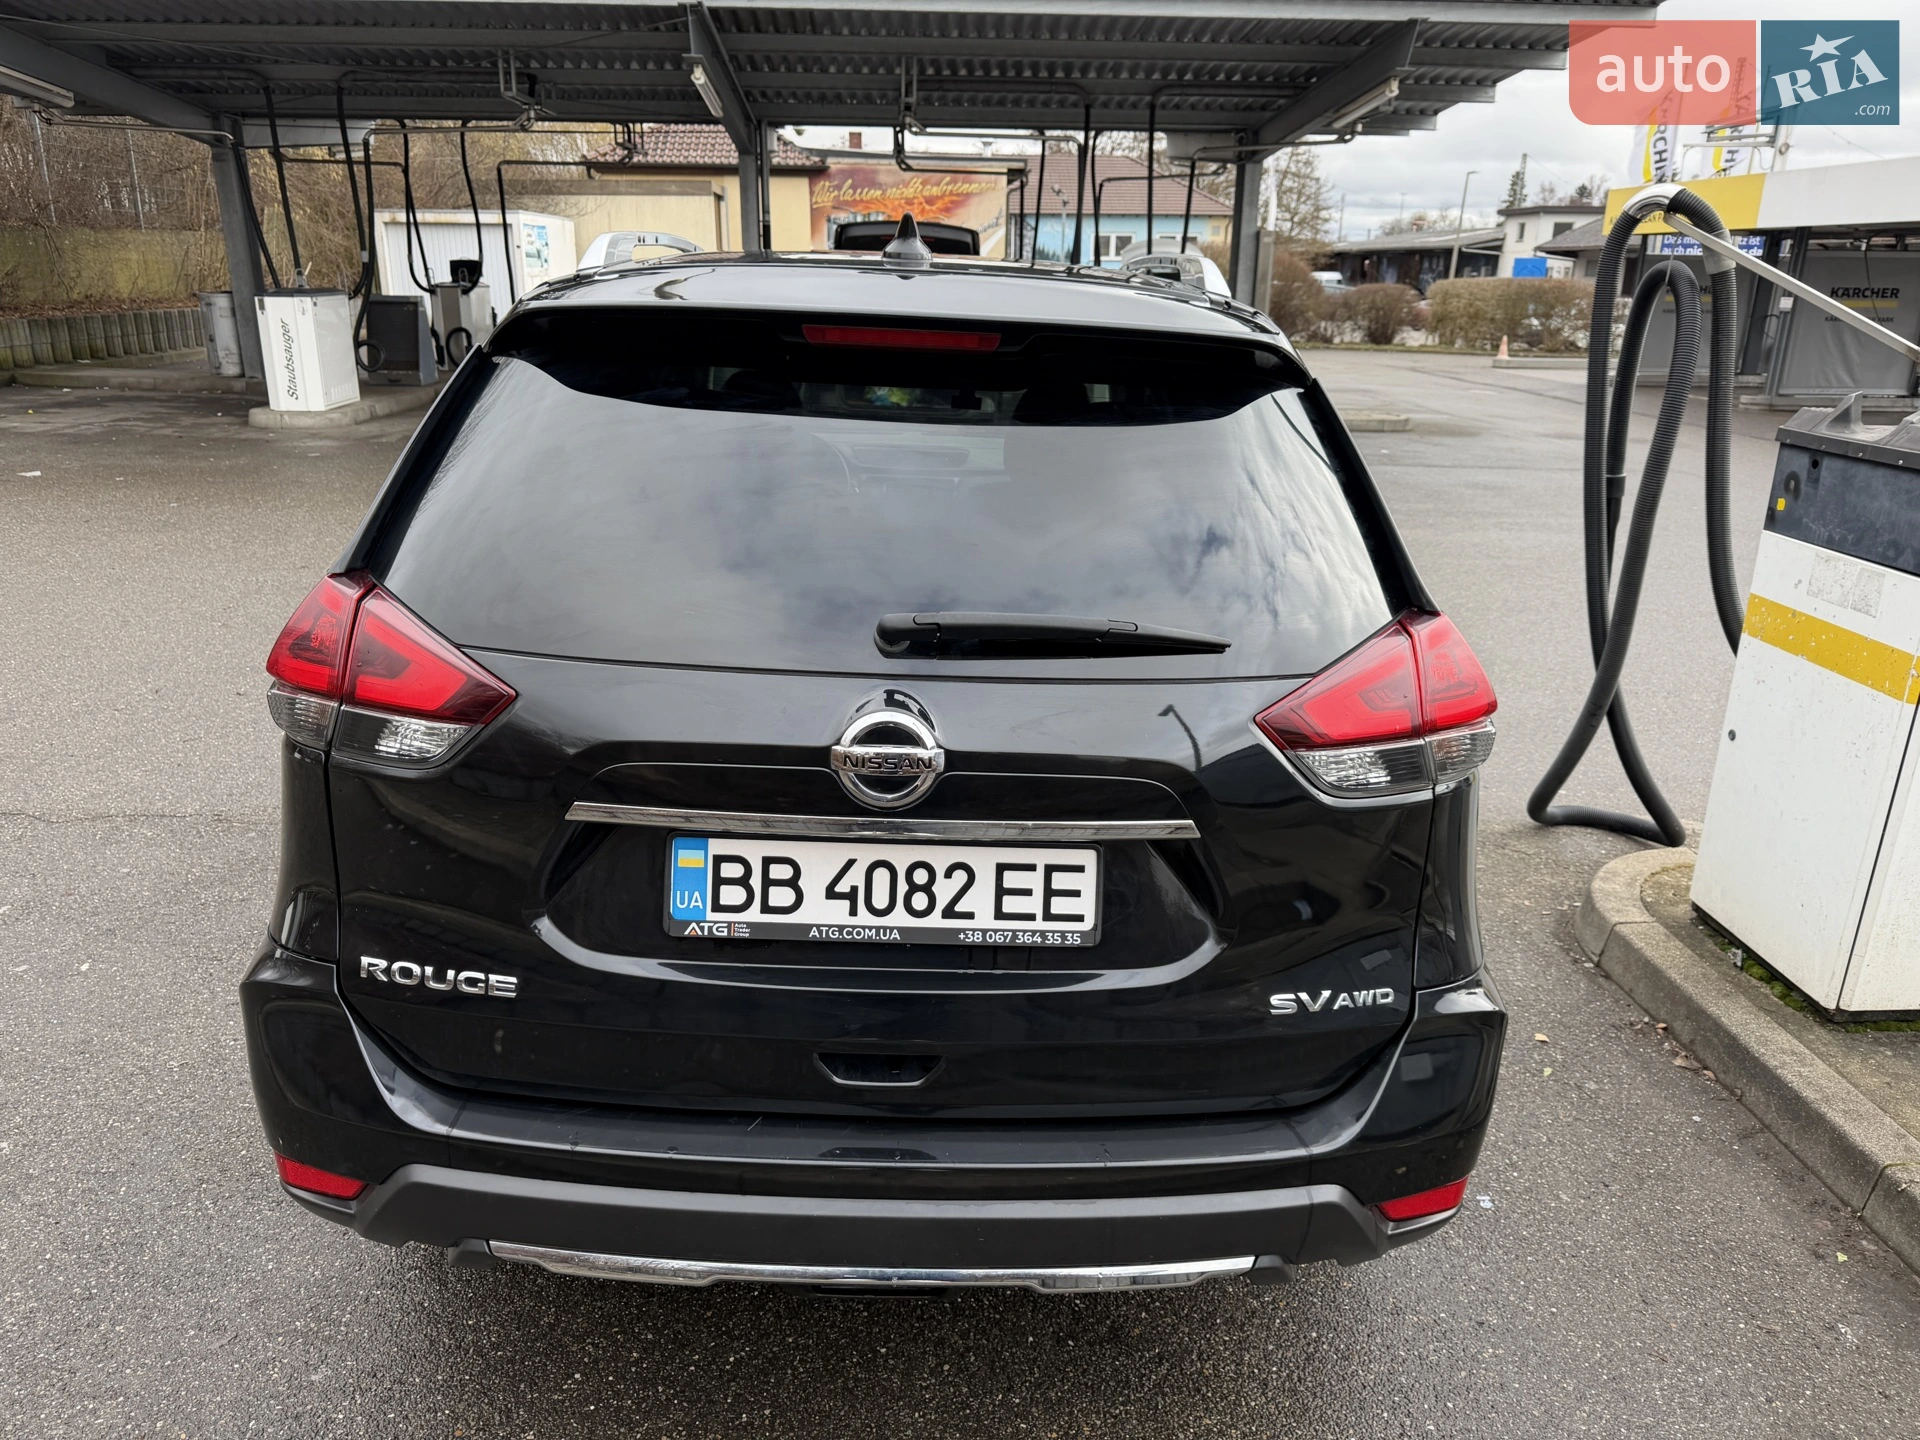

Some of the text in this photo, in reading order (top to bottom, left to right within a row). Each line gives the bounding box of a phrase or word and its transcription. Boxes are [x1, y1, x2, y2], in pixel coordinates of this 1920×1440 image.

[1831, 287, 1900, 299] KÄRCHER
[280, 318, 299, 400] Staubsauger
[843, 754, 933, 771] NISSAN
[711, 854, 1086, 923] BB 4082 EE
[676, 890, 703, 910] UA
[684, 922, 728, 936] ATG
[808, 926, 901, 940] ATG.COM.UA
[958, 931, 1081, 944] +38 067 364 35 35
[359, 955, 518, 999] ROUGE
[1269, 988, 1396, 1016] SV AWD
